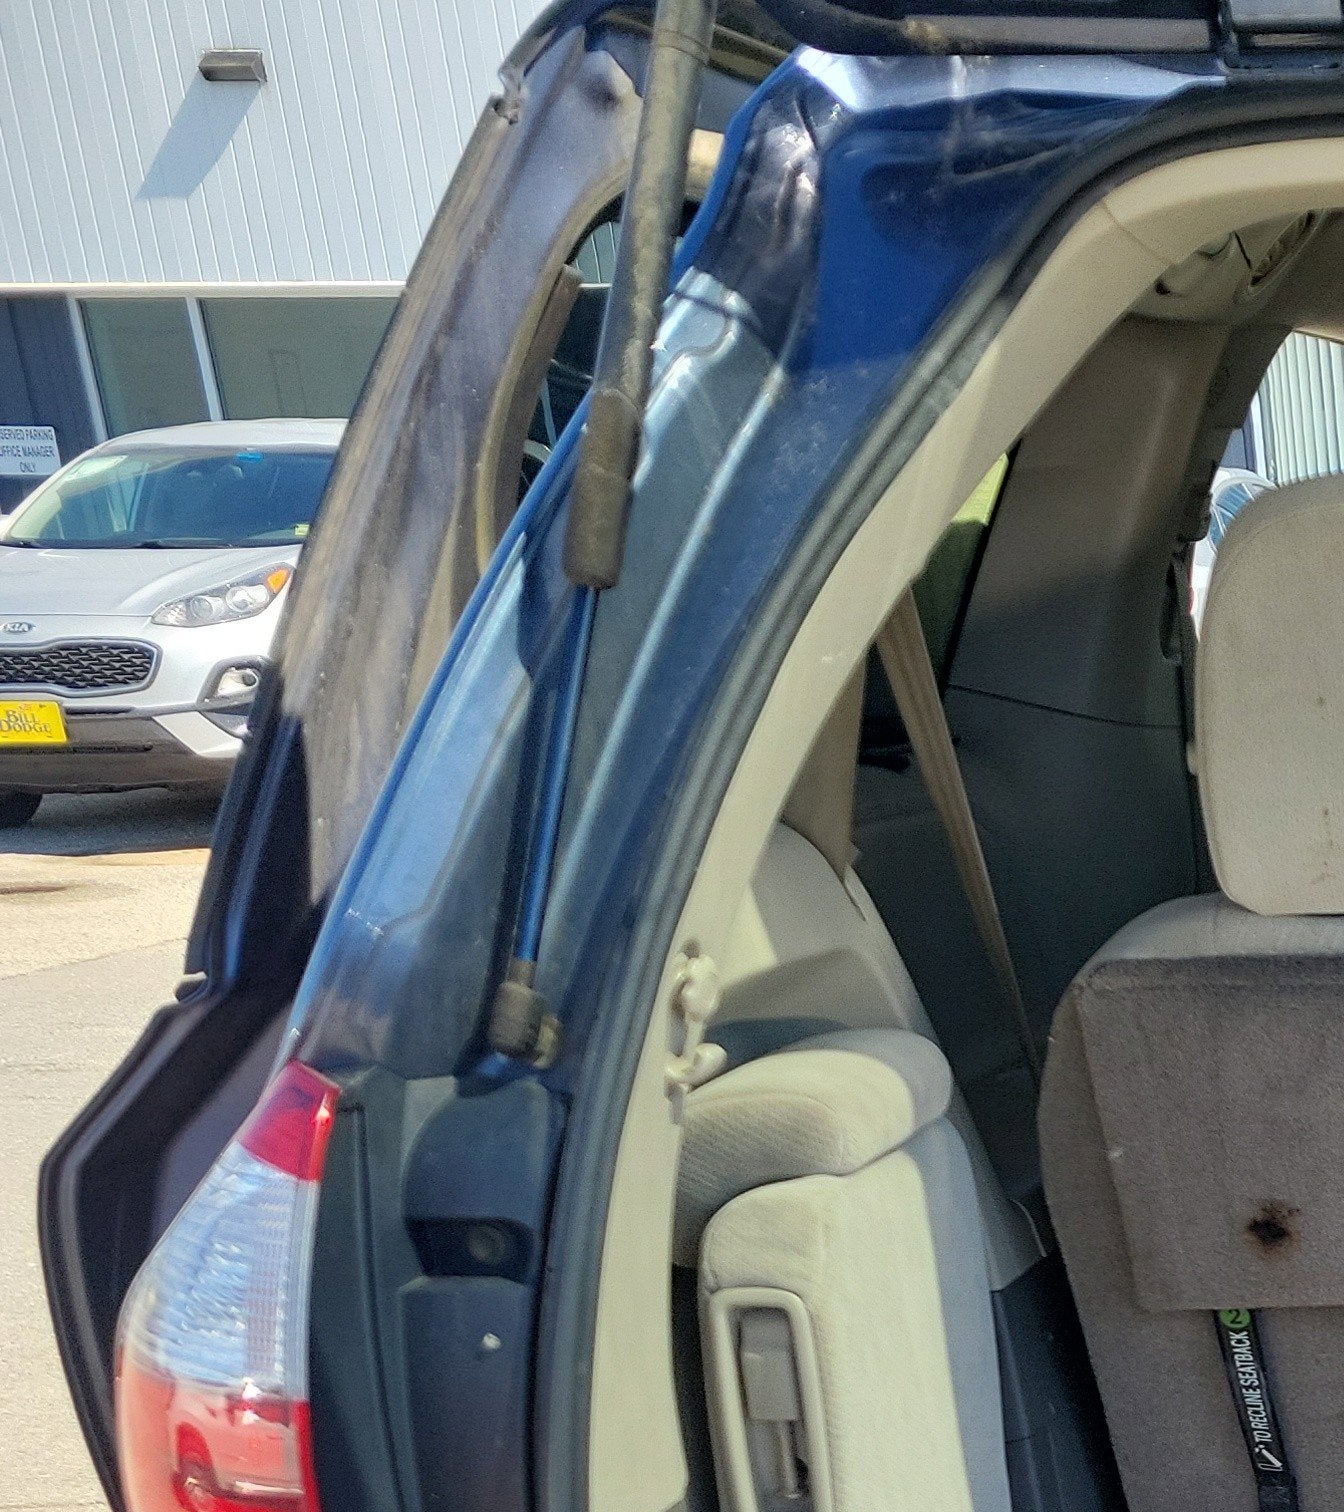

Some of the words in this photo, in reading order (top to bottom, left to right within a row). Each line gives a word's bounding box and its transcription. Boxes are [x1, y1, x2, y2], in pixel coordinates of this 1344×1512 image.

[25, 429, 53, 440] PARKING
[21, 446, 55, 457] MANAGER
[20, 462, 36, 473] ONLY
[7, 709, 38, 722] BILL
[1228, 1309, 1242, 1324] 2
[1229, 1331, 1259, 1387] SEATBACK
[1242, 1388, 1272, 1431] RECLINE
[1254, 1431, 1273, 1443] TO
